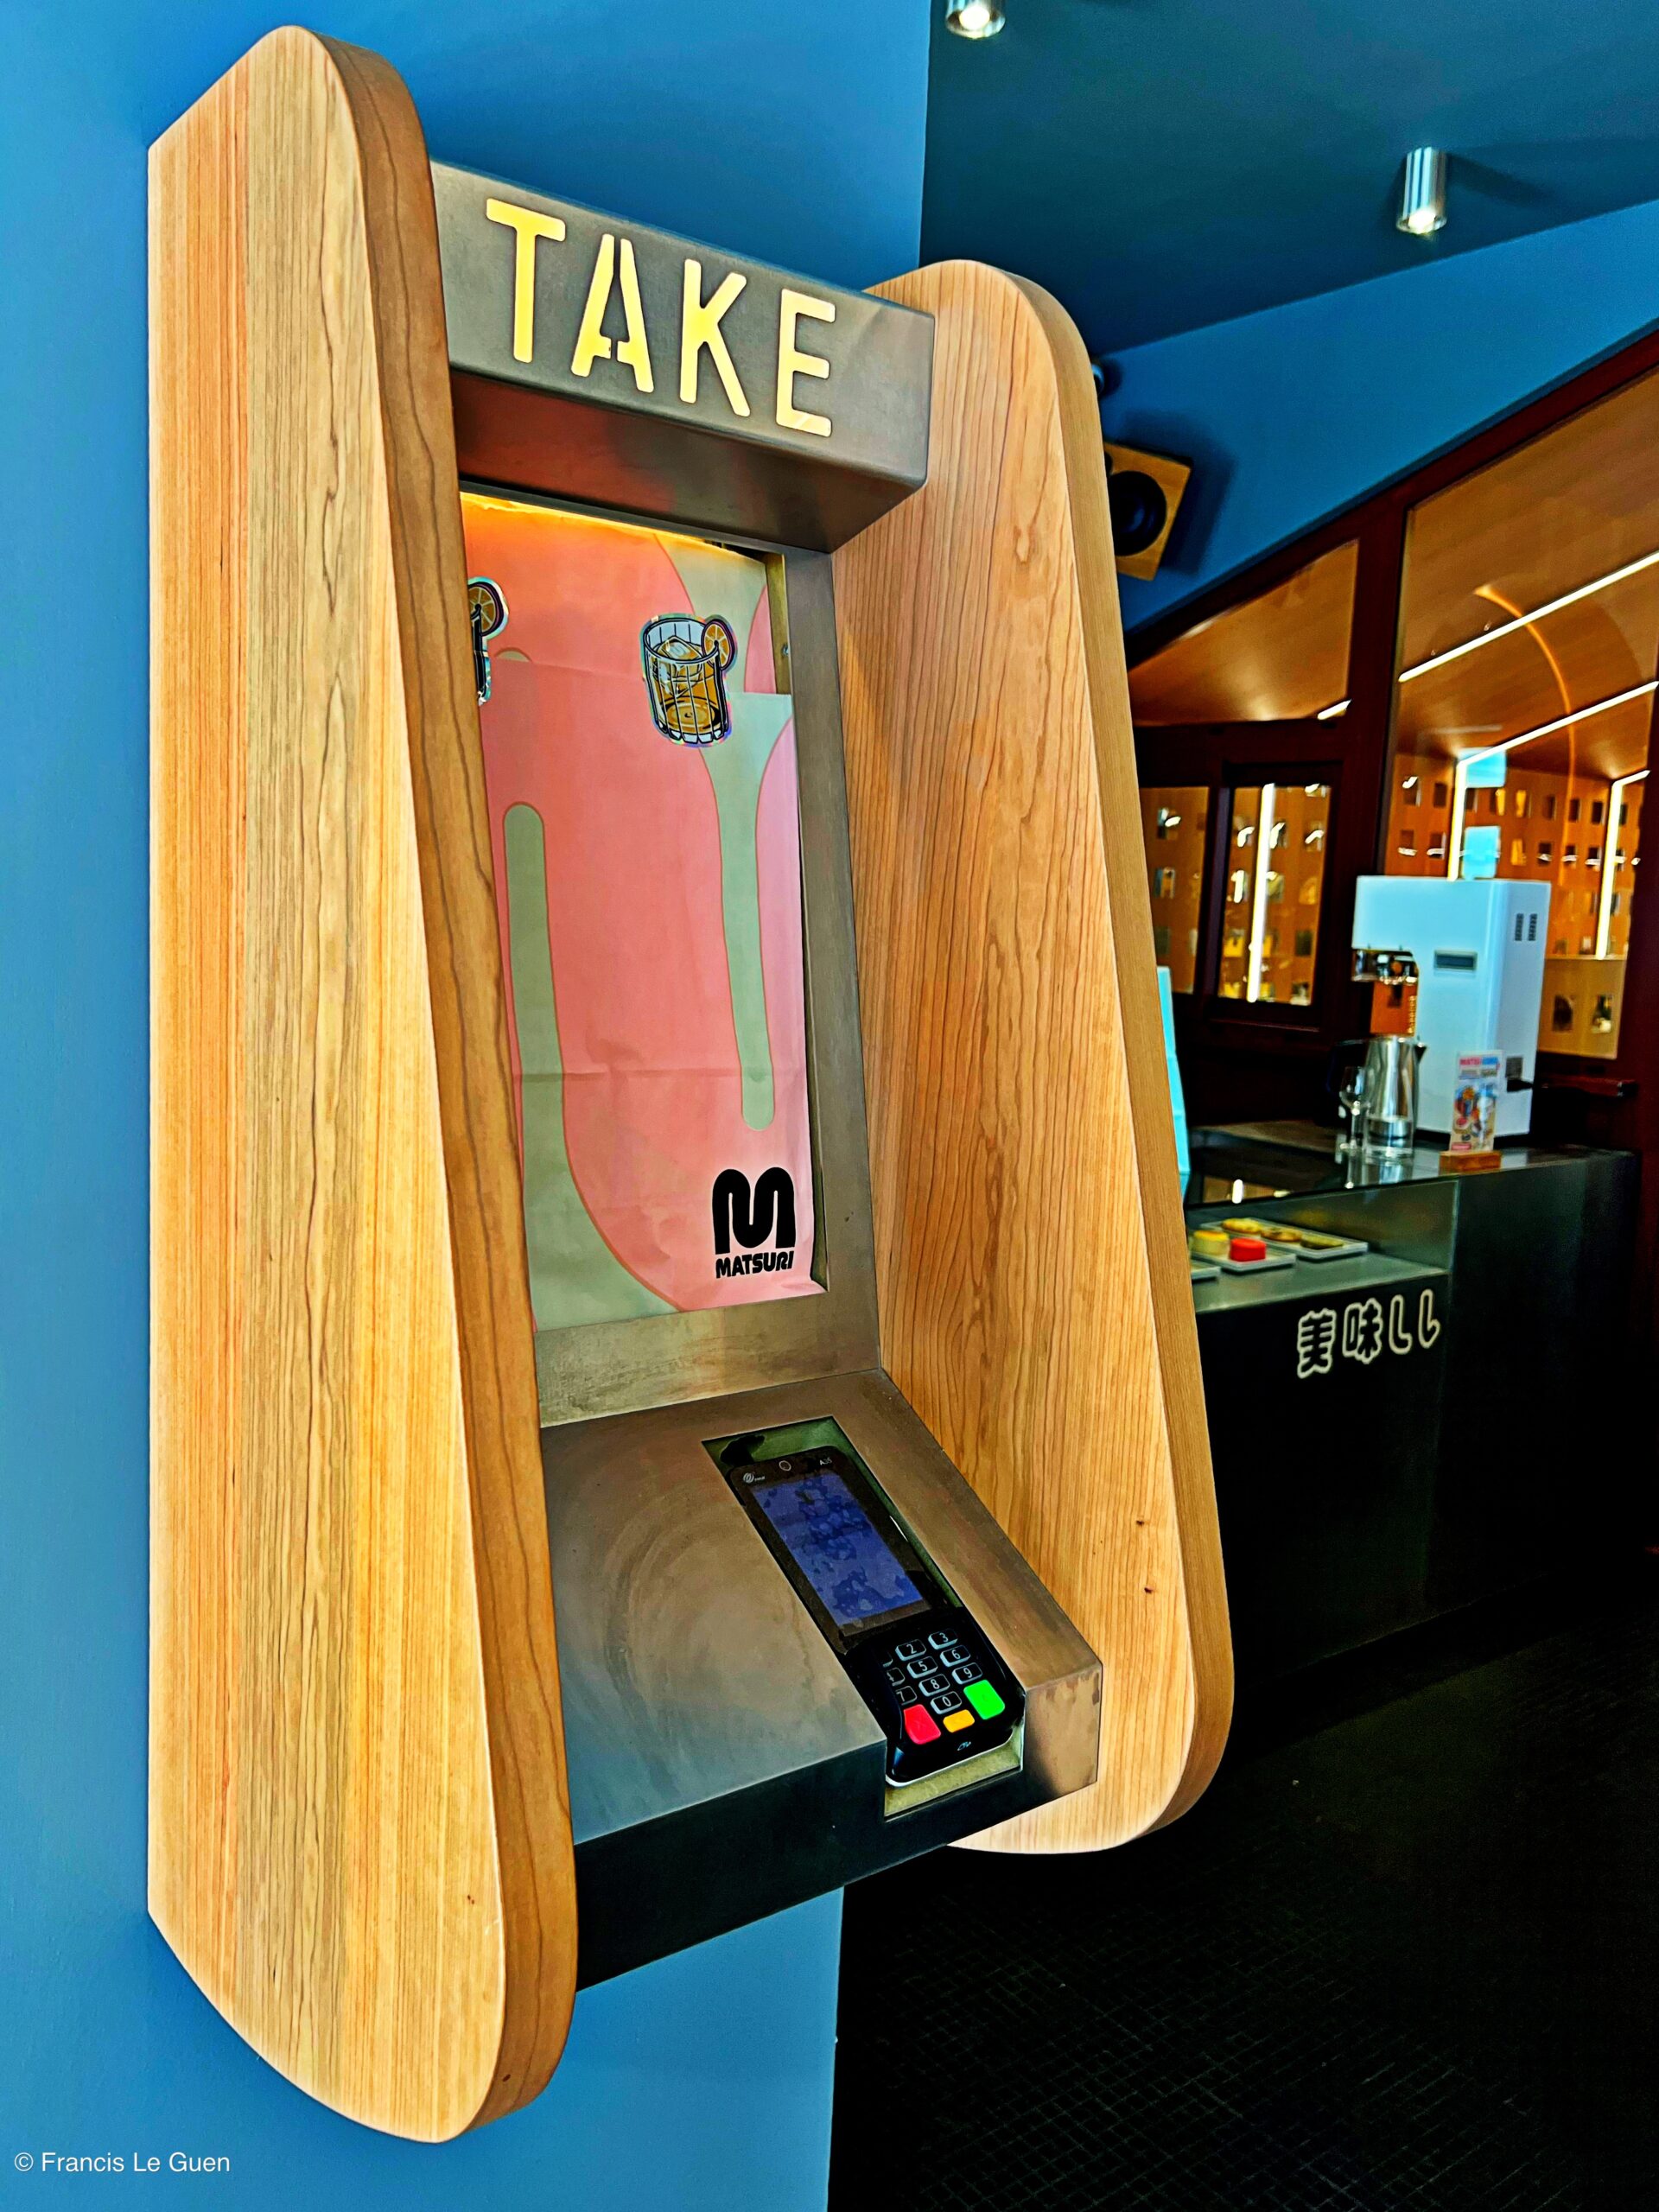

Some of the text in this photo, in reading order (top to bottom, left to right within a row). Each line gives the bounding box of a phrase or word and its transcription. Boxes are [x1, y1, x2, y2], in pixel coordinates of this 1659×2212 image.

[486, 198, 836, 437] TAKE
[715, 1250, 795, 1279] MATSURI
[906, 1632, 949, 1655] 2 3
[918, 1661, 928, 1672] 5
[951, 1649, 961, 1660] 6
[896, 1667, 973, 1702] 7 8 9
[942, 1696, 951, 1707] 0
